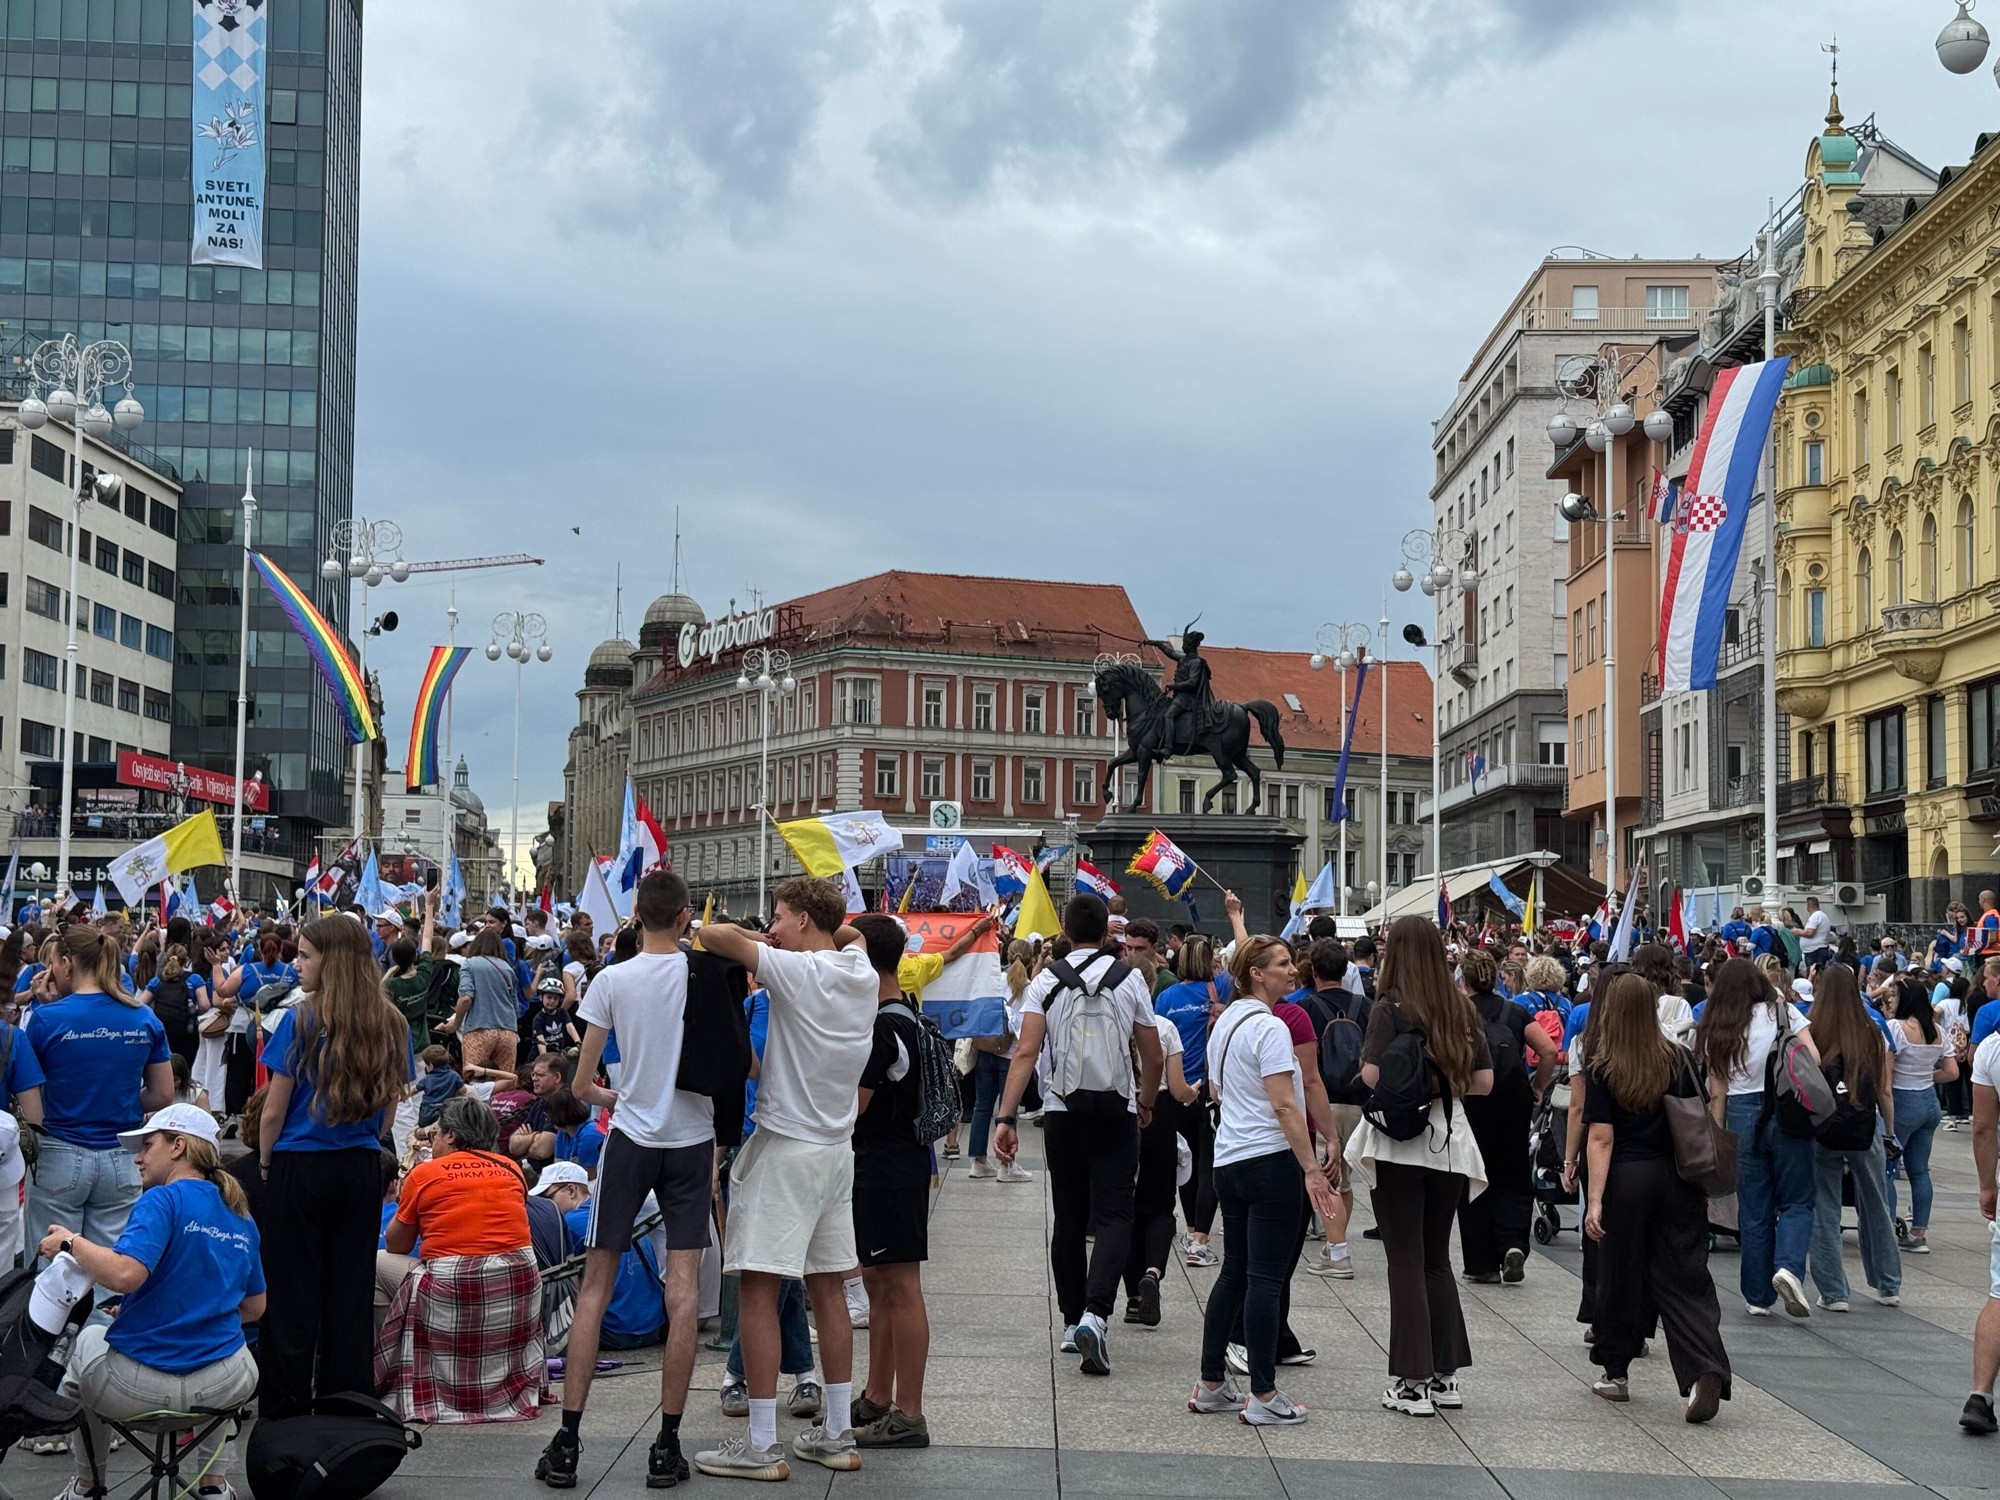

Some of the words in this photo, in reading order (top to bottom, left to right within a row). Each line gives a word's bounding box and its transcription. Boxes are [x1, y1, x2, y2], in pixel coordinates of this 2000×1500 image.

[205, 180, 250, 193] SVETI
[197, 194, 259, 211] ANTUNE,
[209, 208, 245, 221] MOLI
[216, 223, 236, 234] ZA
[208, 236, 243, 249] NAS!
[61, 1030, 79, 1042] Ako
[96, 1027, 122, 1040] Boga,
[447, 1171, 485, 1181] SHKM
[184, 1220, 200, 1234] Ako
[208, 1226, 231, 1241] Boga,
